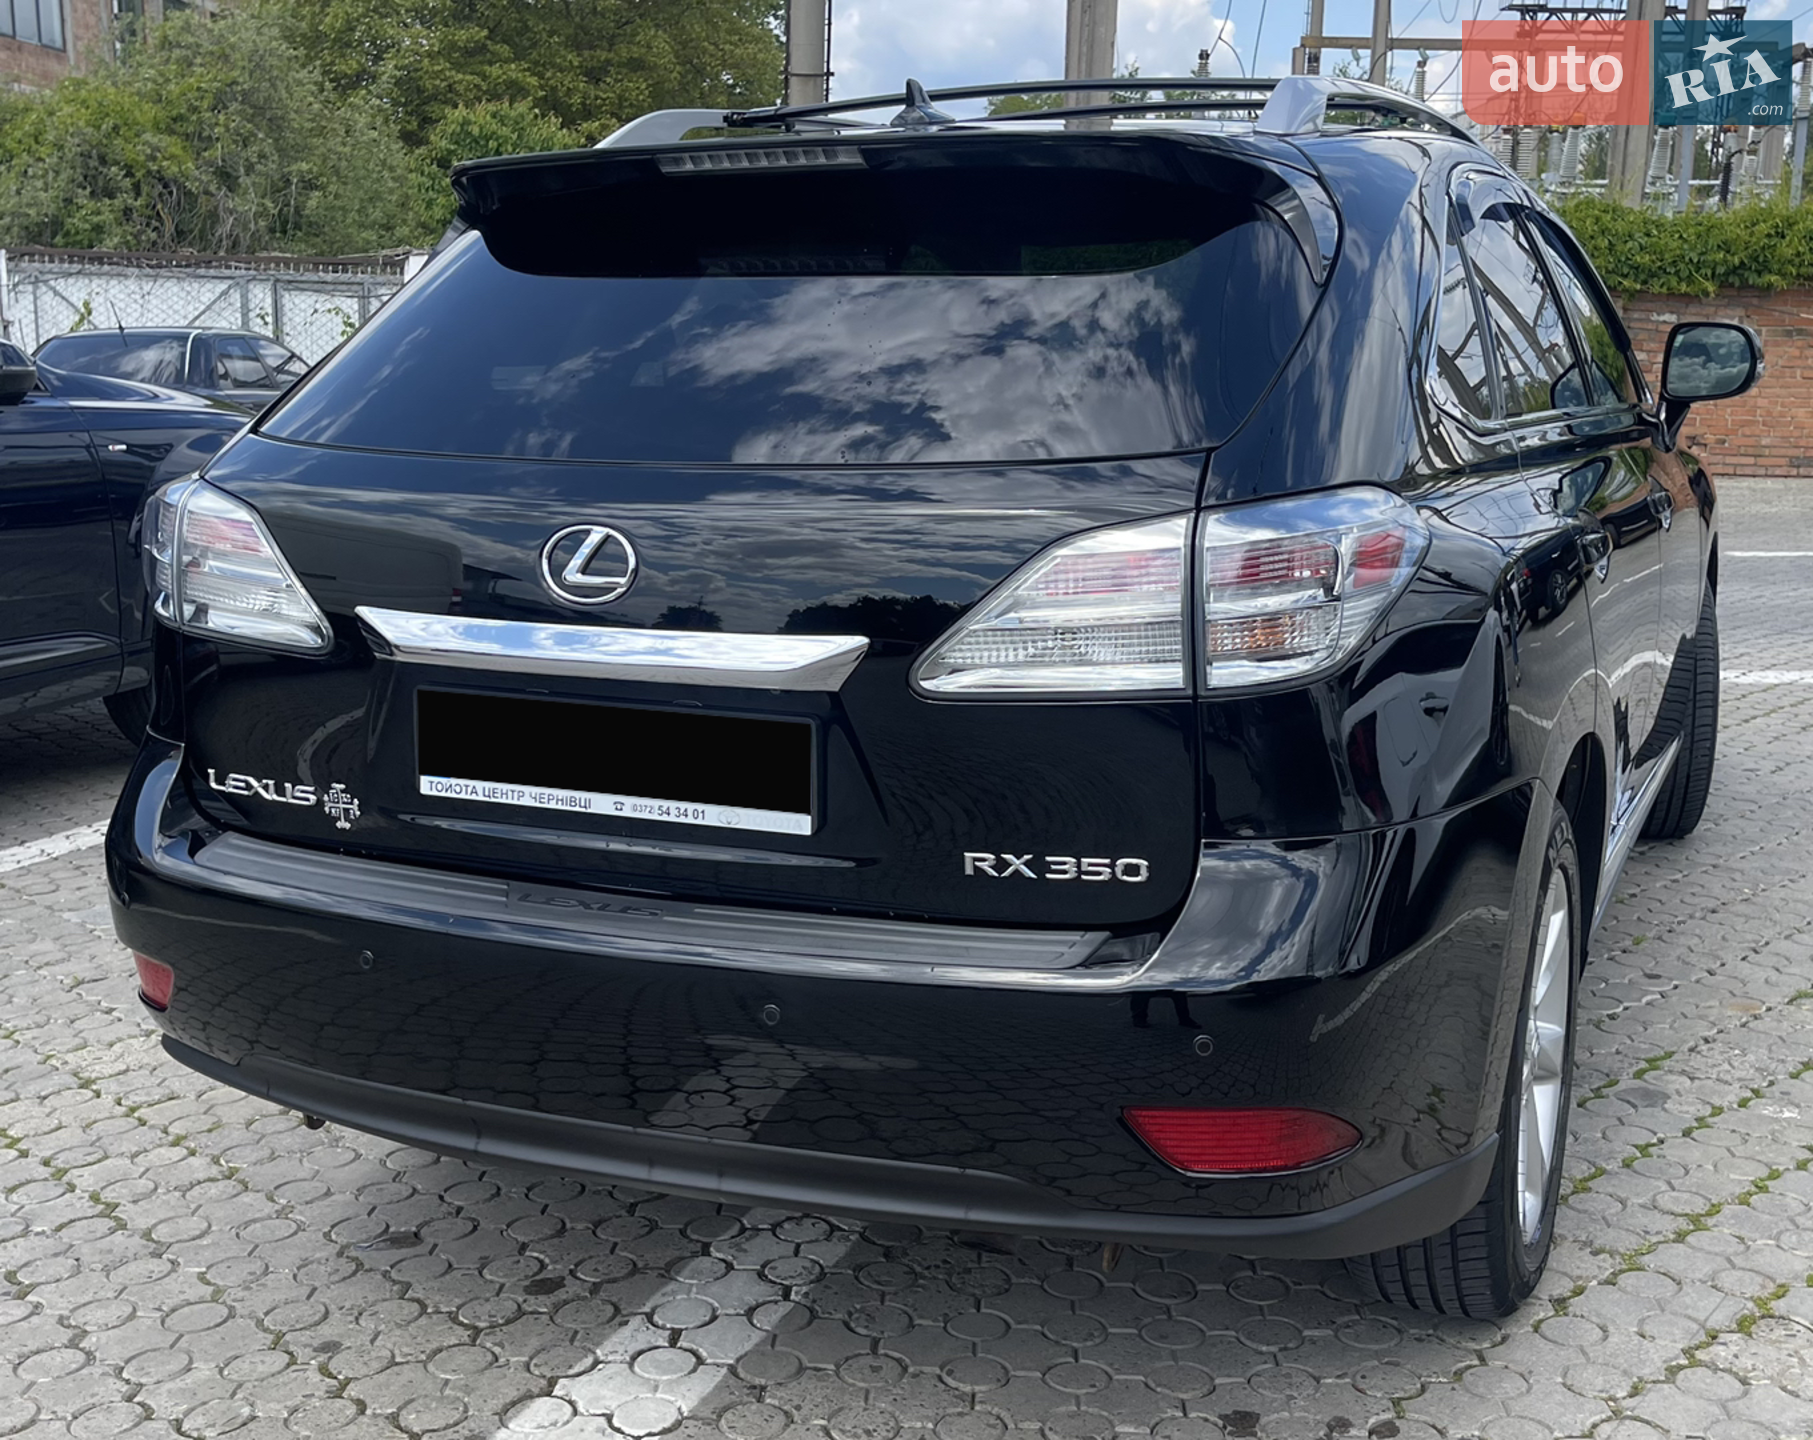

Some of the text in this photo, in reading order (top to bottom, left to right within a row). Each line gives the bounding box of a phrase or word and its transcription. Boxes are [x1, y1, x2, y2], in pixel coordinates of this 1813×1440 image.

[207, 768, 317, 806] LEXUS
[428, 780, 592, 810] ТОЙОТА ЦЕНТР ЧЕРНІВЦІ
[657, 804, 671, 817] 54
[674, 806, 689, 819] 34
[692, 808, 706, 821] 01
[746, 813, 804, 831] TOYOTA
[963, 852, 1149, 882] RX 350
[517, 893, 663, 917] LEXUS
